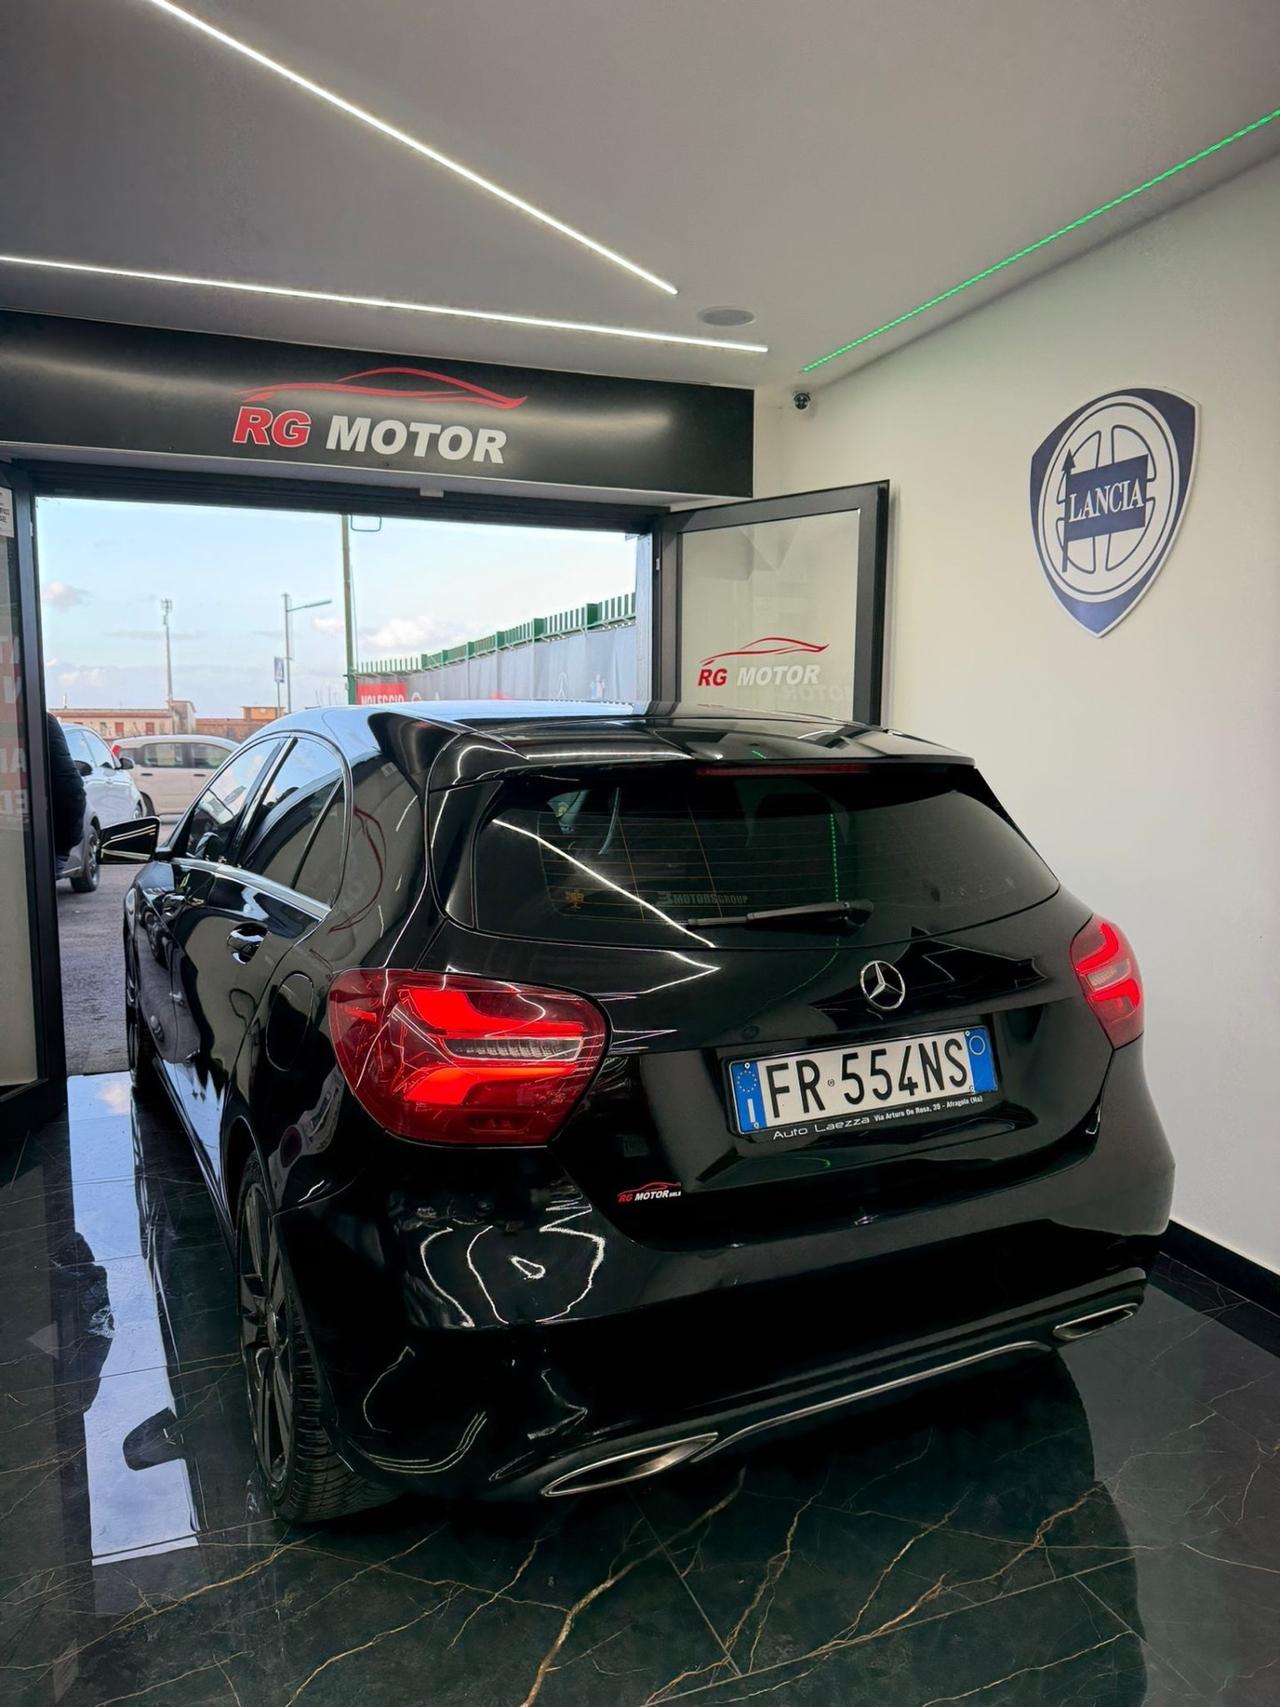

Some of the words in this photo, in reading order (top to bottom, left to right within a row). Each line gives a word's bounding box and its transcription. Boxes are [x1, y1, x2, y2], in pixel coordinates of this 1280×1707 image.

[232, 406, 311, 448] RG
[325, 415, 507, 464] MOTOR
[1069, 478, 1144, 522] LANCIA
[697, 668, 728, 687] RG
[737, 664, 821, 687] MOTOR
[773, 1127, 808, 1140] Auto
[815, 1116, 869, 1133] Laezza
[874, 1114, 885, 1122] Via
[886, 1111, 905, 1120] Arturo
[634, 1190, 669, 1201] MOTOR
